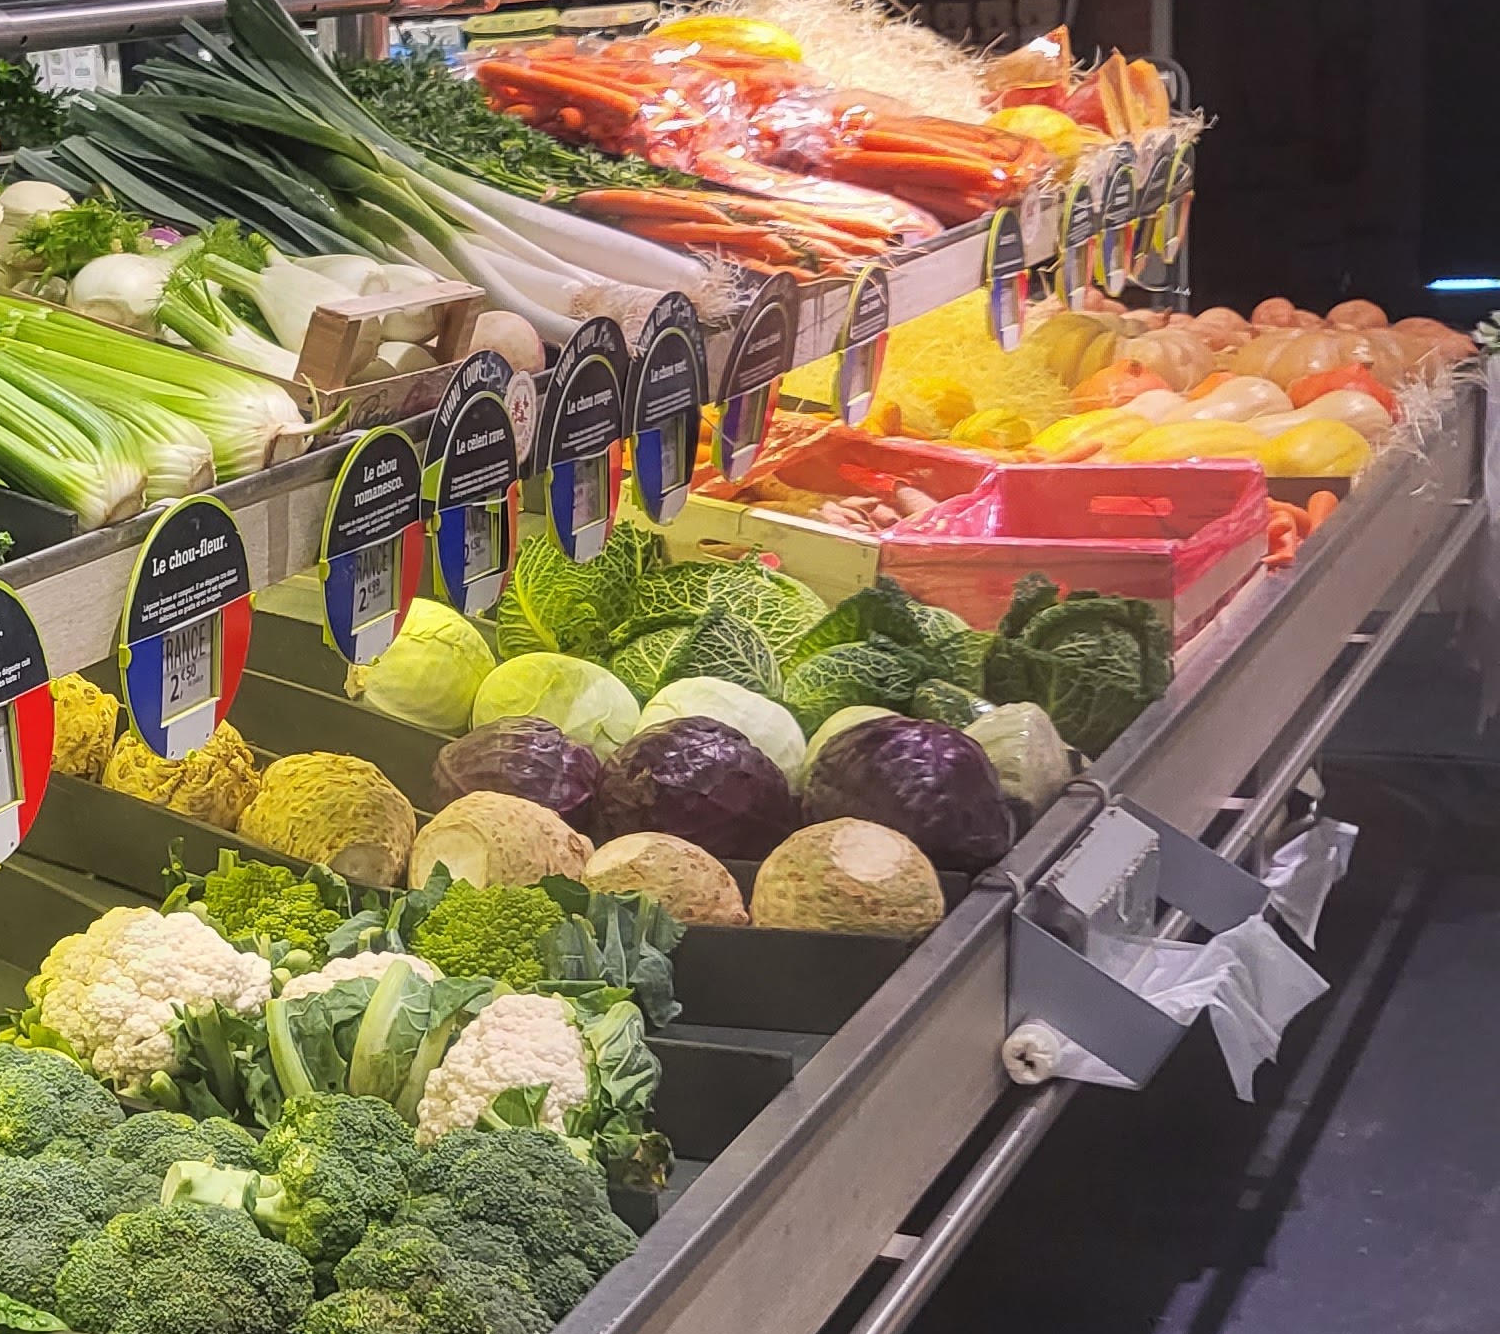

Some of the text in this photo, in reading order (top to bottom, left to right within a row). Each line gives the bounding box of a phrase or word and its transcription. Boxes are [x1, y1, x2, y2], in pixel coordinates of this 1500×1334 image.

[440, 381, 461, 427] VENDU
[456, 439, 466, 455] Le
[363, 457, 397, 483] Le chou
[354, 476, 404, 507] romanesco.
[152, 535, 228, 577] Le chou-fleur.
[356, 542, 388, 585] RANCE
[163, 623, 206, 672] RANCE
